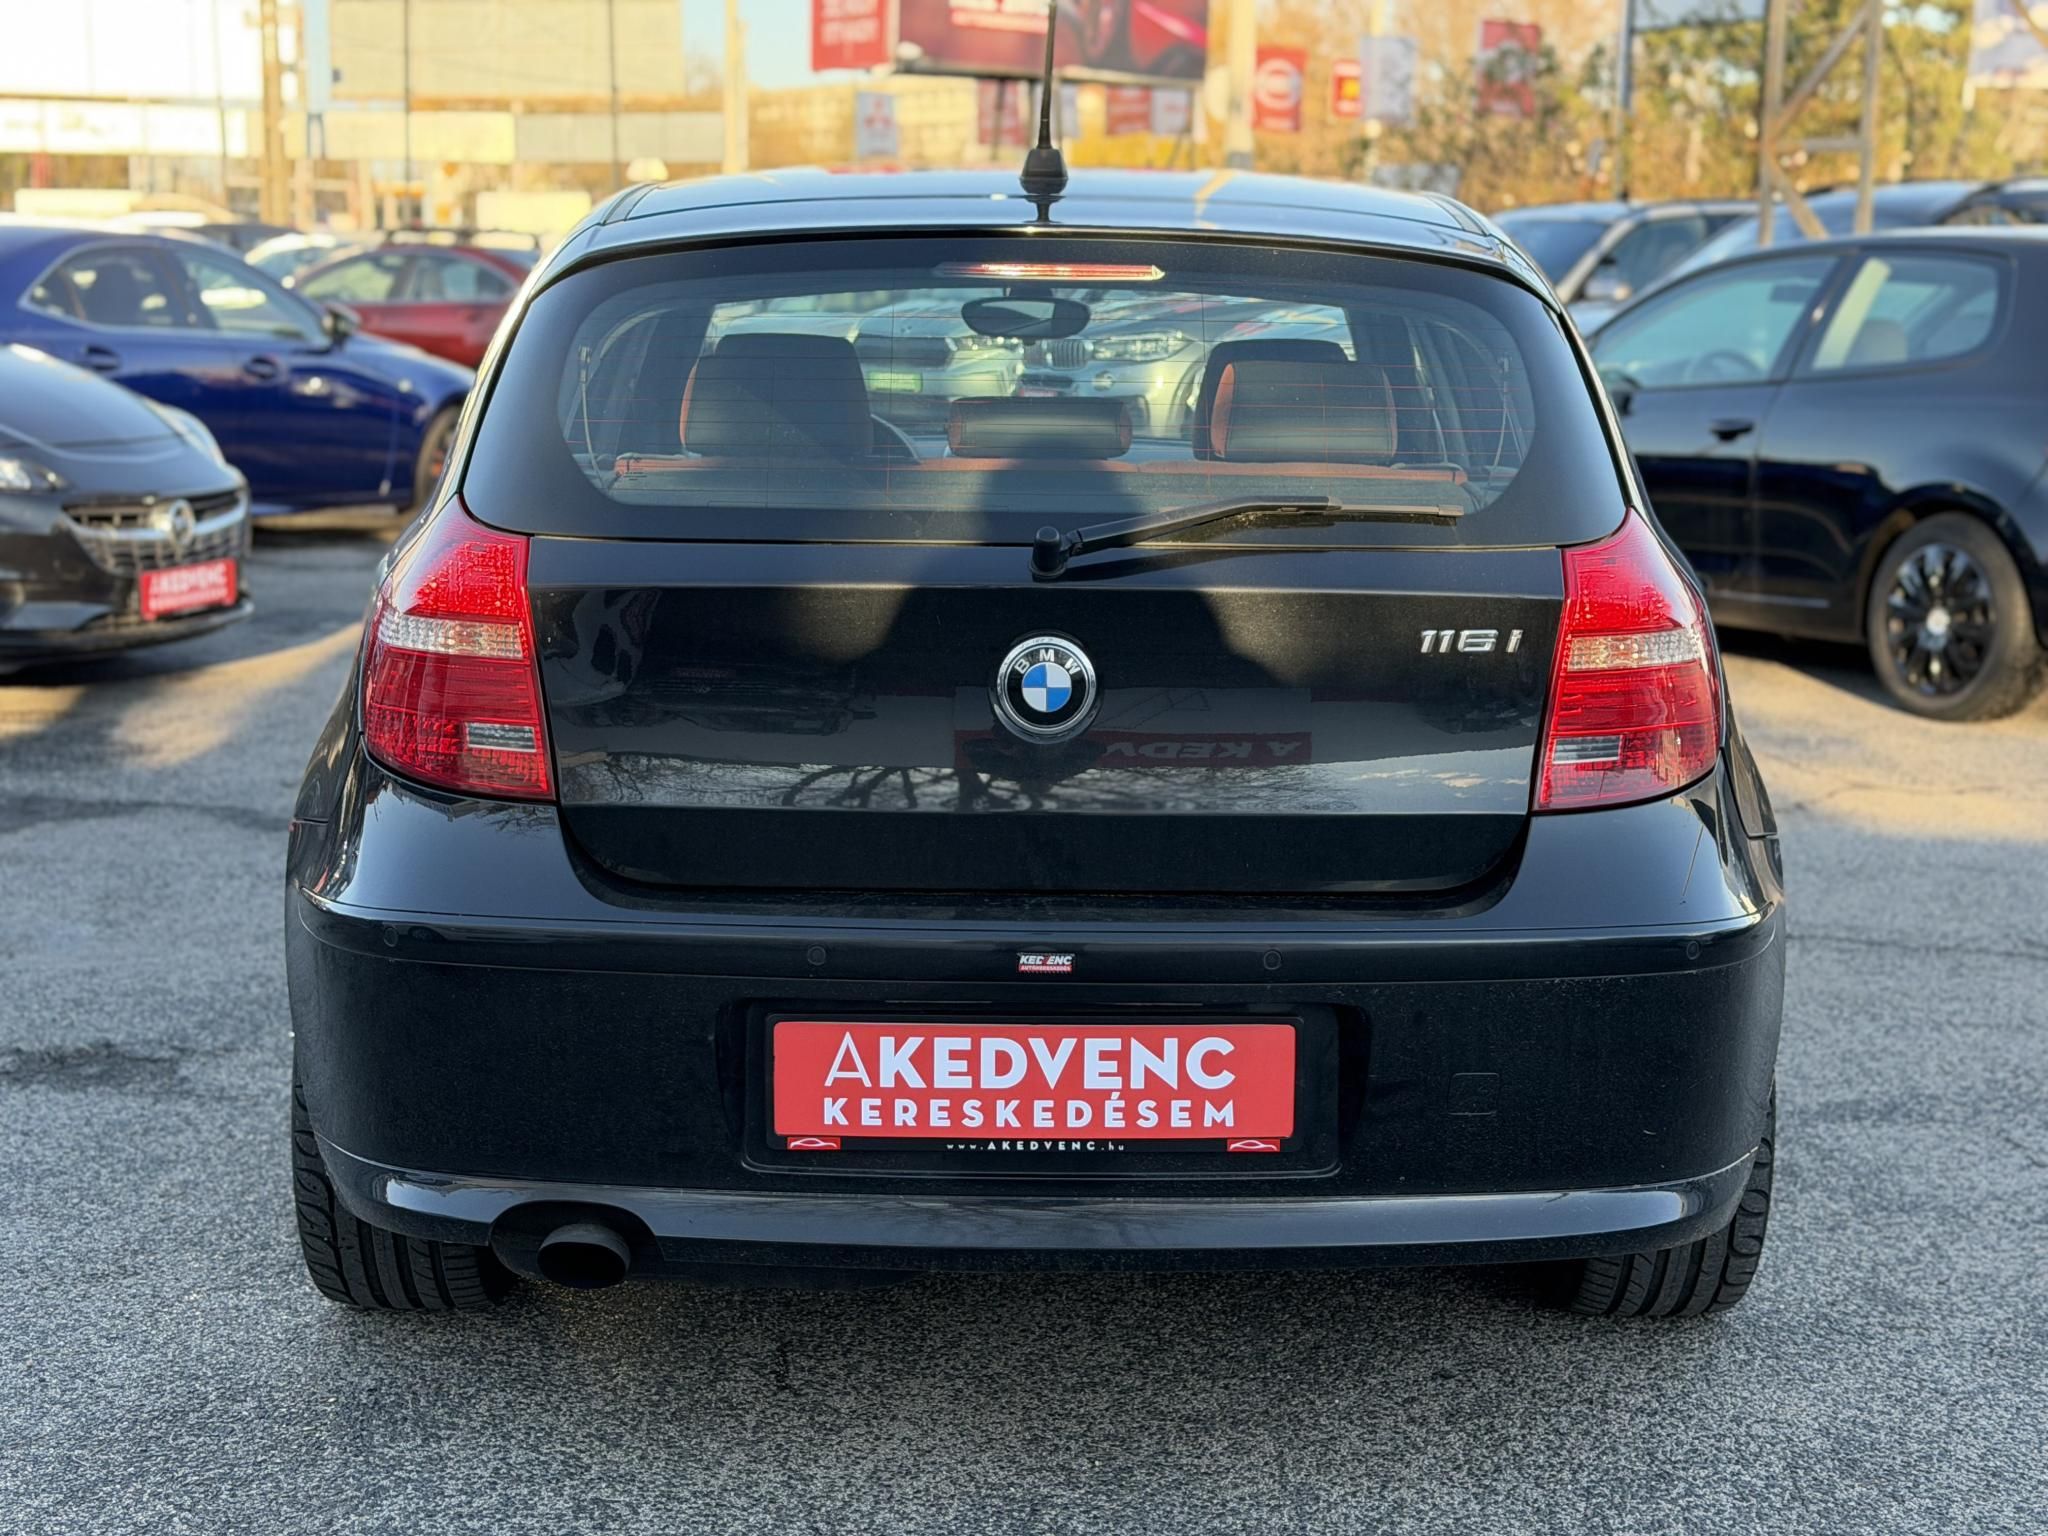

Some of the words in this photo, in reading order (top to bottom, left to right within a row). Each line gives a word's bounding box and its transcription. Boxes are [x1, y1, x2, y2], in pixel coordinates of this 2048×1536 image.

[1421, 629, 1499, 653] 116
[1014, 648, 1081, 675] BMW
[825, 1031, 1236, 1090] AKEDVENC
[823, 1092, 1234, 1128] KERESKEDÉSEM
[947, 1141, 1125, 1151] www.AKEDVENC.hu
